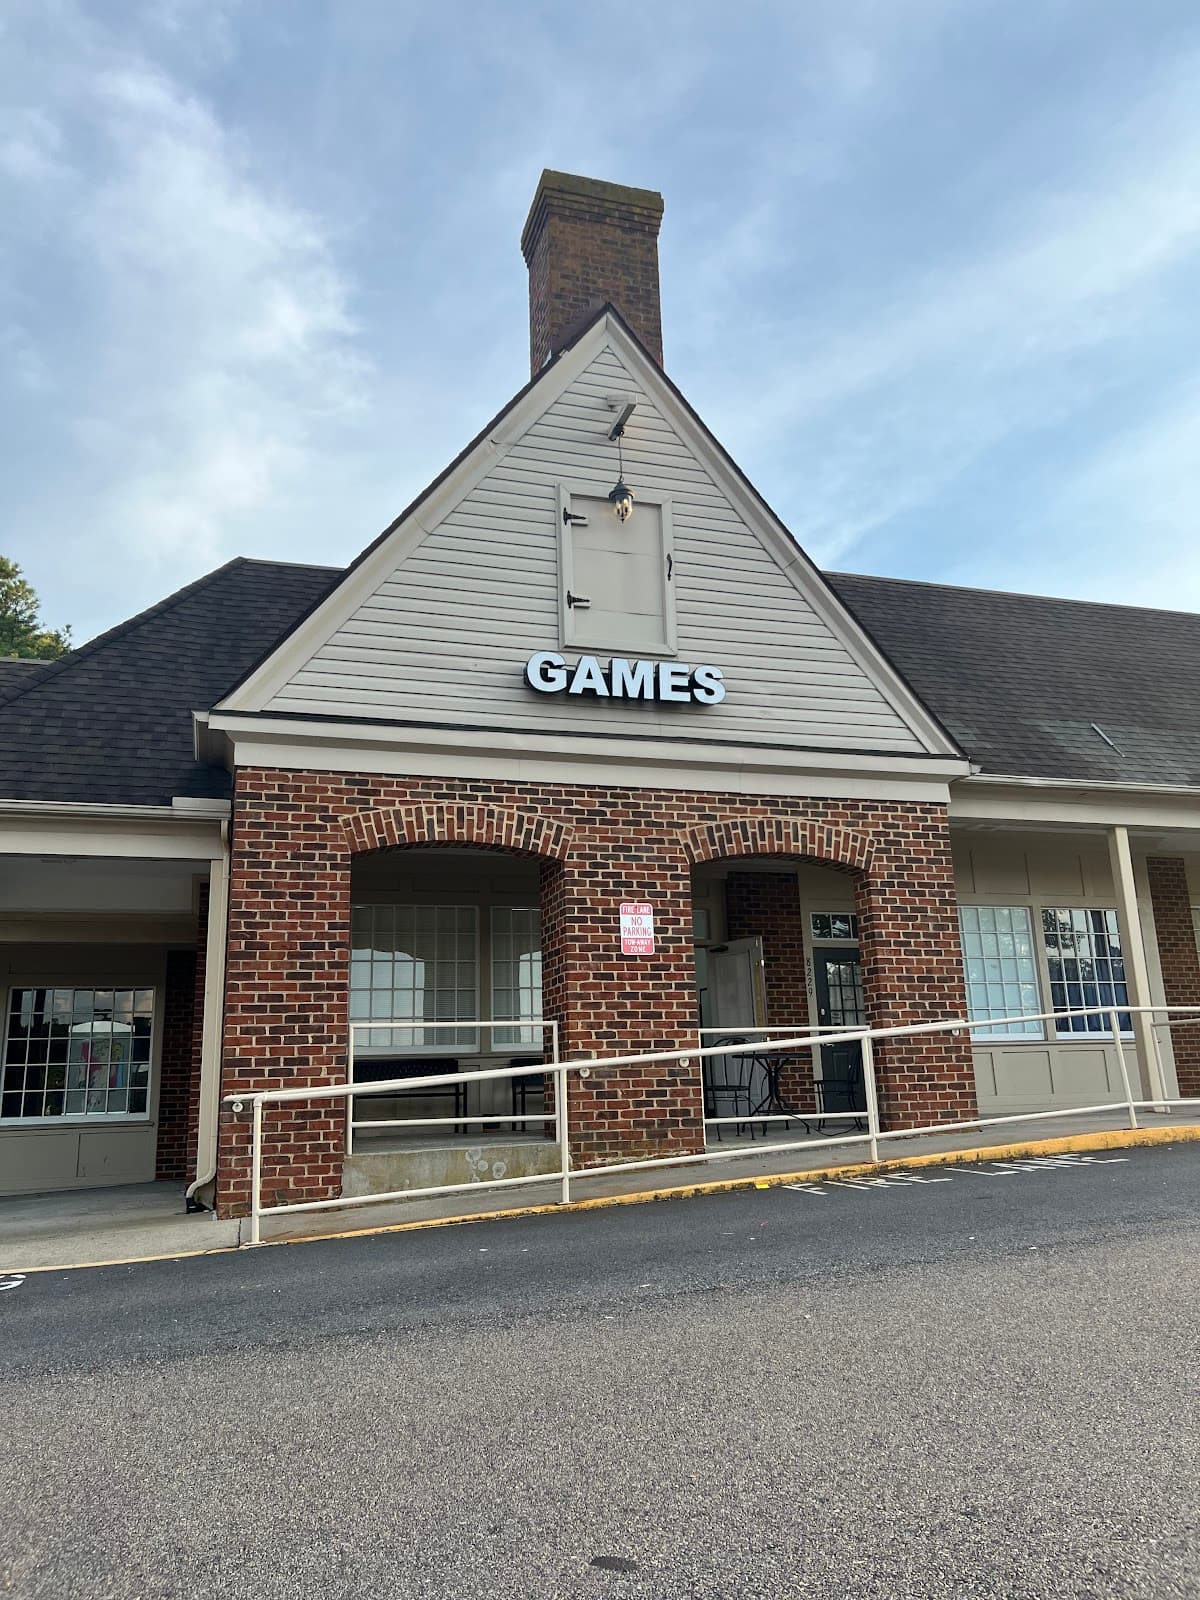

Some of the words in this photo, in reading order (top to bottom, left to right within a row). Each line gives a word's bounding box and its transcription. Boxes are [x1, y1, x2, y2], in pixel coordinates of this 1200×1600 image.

[526, 651, 726, 705] GAMES
[622, 906, 635, 914] FIRE
[637, 906, 651, 914] LANE
[631, 916, 643, 926] NO
[622, 926, 652, 937] PARKING
[780, 1172, 952, 1195] FIRE
